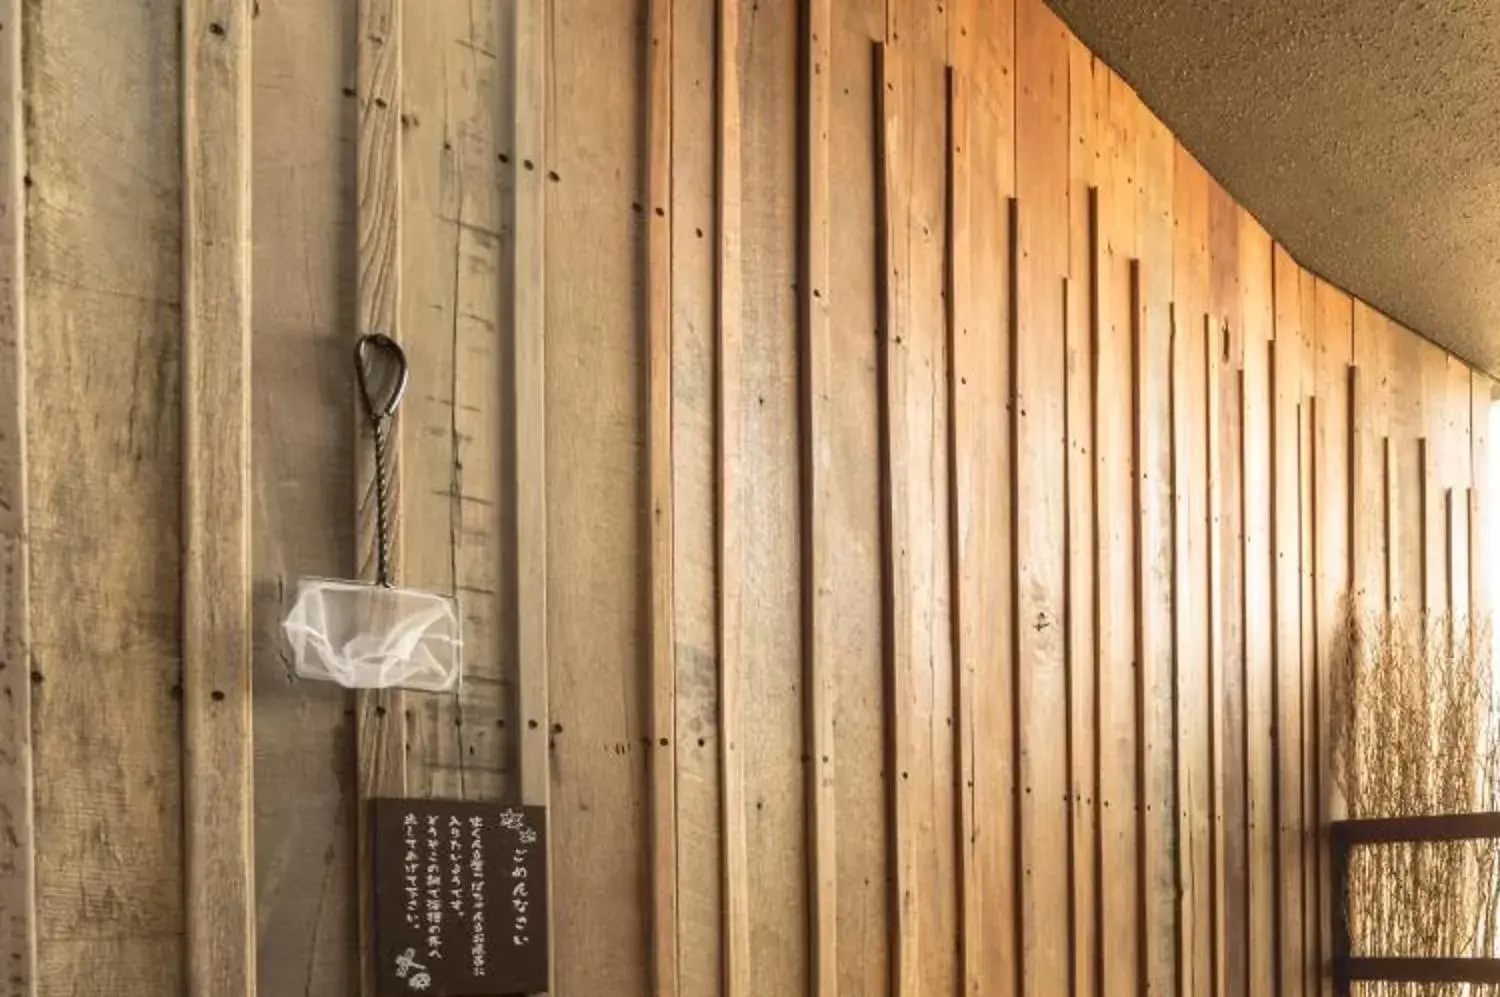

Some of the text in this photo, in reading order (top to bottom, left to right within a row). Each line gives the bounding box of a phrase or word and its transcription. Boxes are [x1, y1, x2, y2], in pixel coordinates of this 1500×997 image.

[404, 812, 421, 929] 出してあげて下さい。
[512, 848, 529, 945] ごめんなさい
